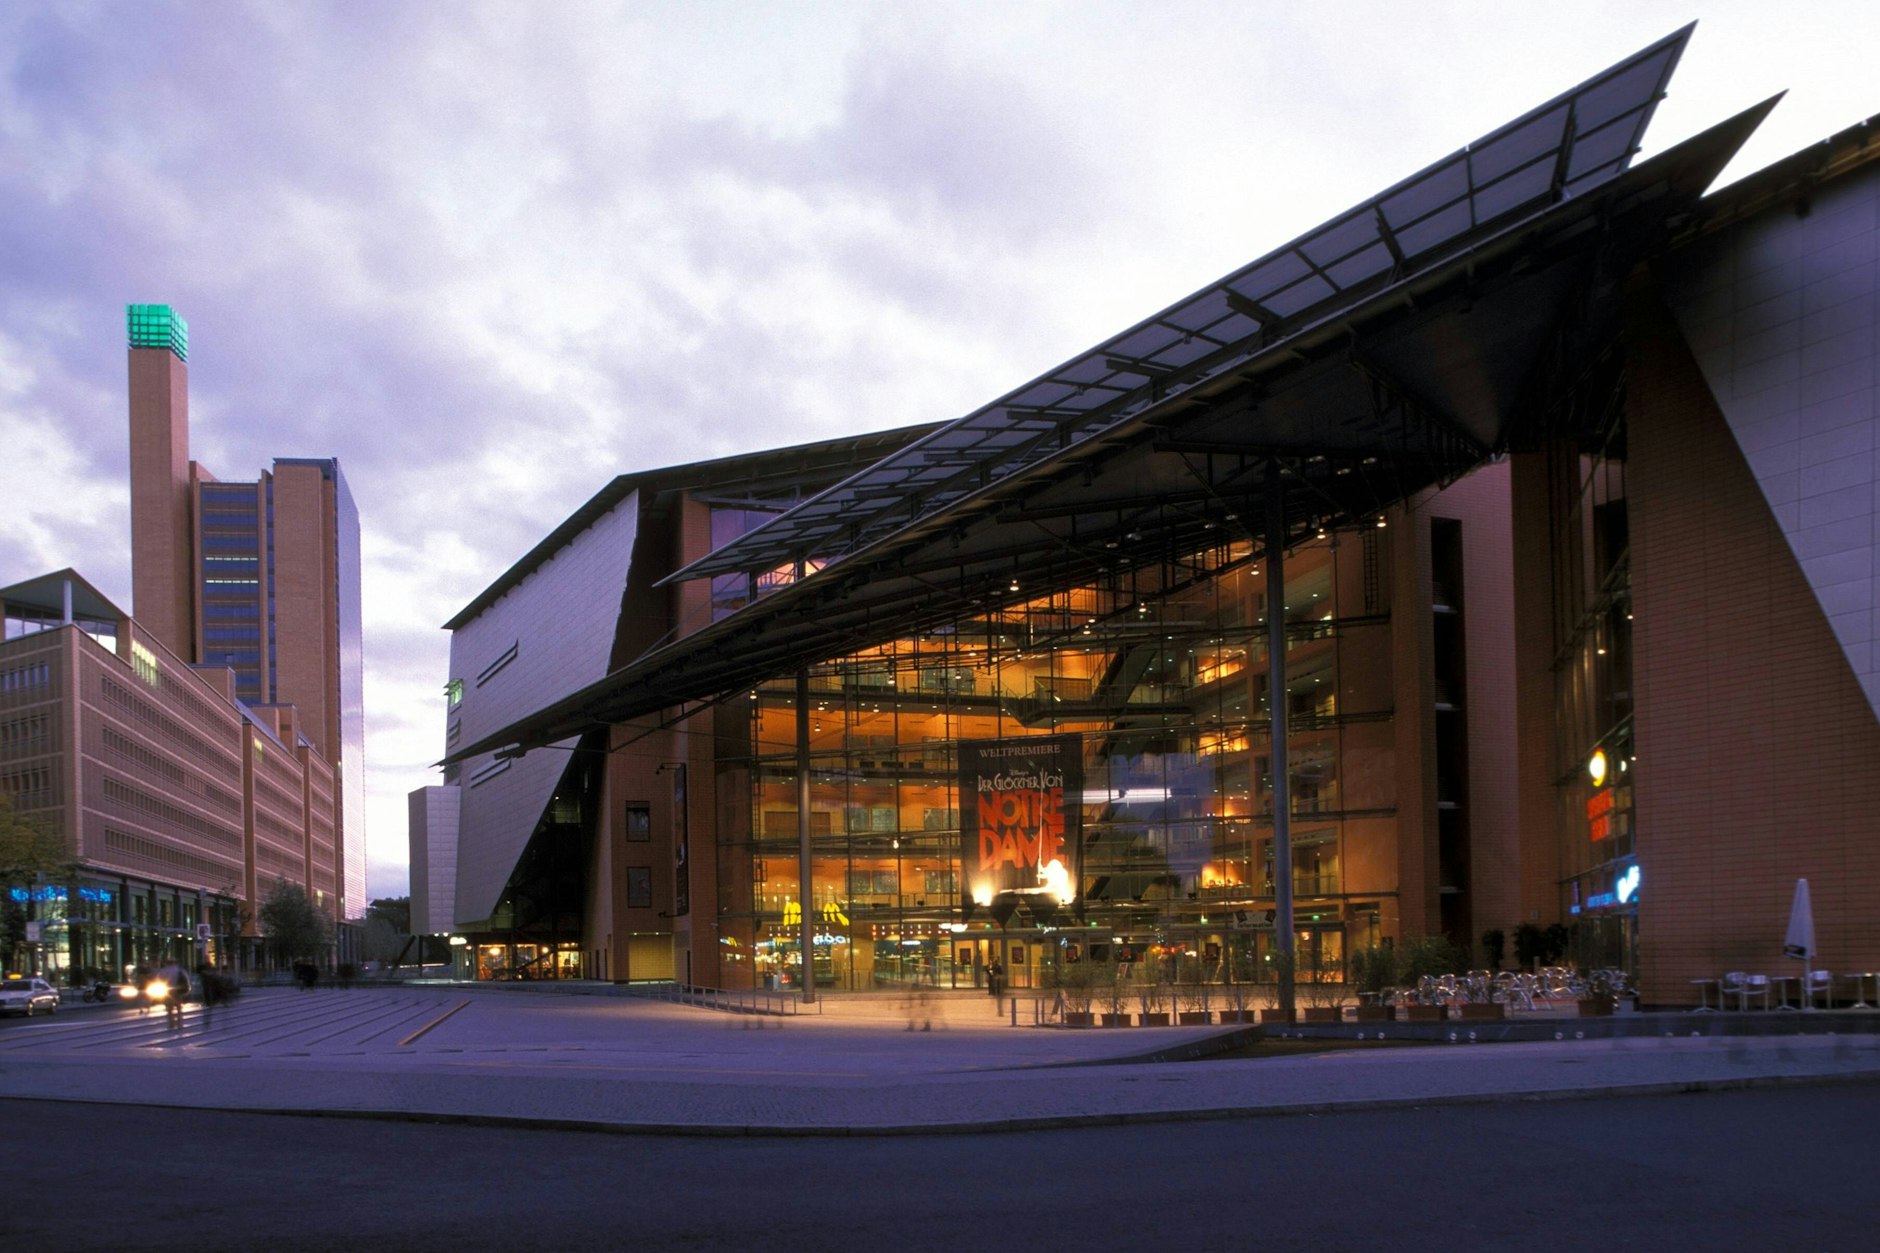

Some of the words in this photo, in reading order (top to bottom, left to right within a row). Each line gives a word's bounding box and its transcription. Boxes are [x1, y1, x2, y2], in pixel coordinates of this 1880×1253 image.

[979, 744, 1061, 758] WELTPREMIERE
[978, 775, 994, 792] DER
[1040, 767, 1064, 789] VON
[978, 787, 1065, 830] NOTRE
[978, 826, 1067, 871] DAME
